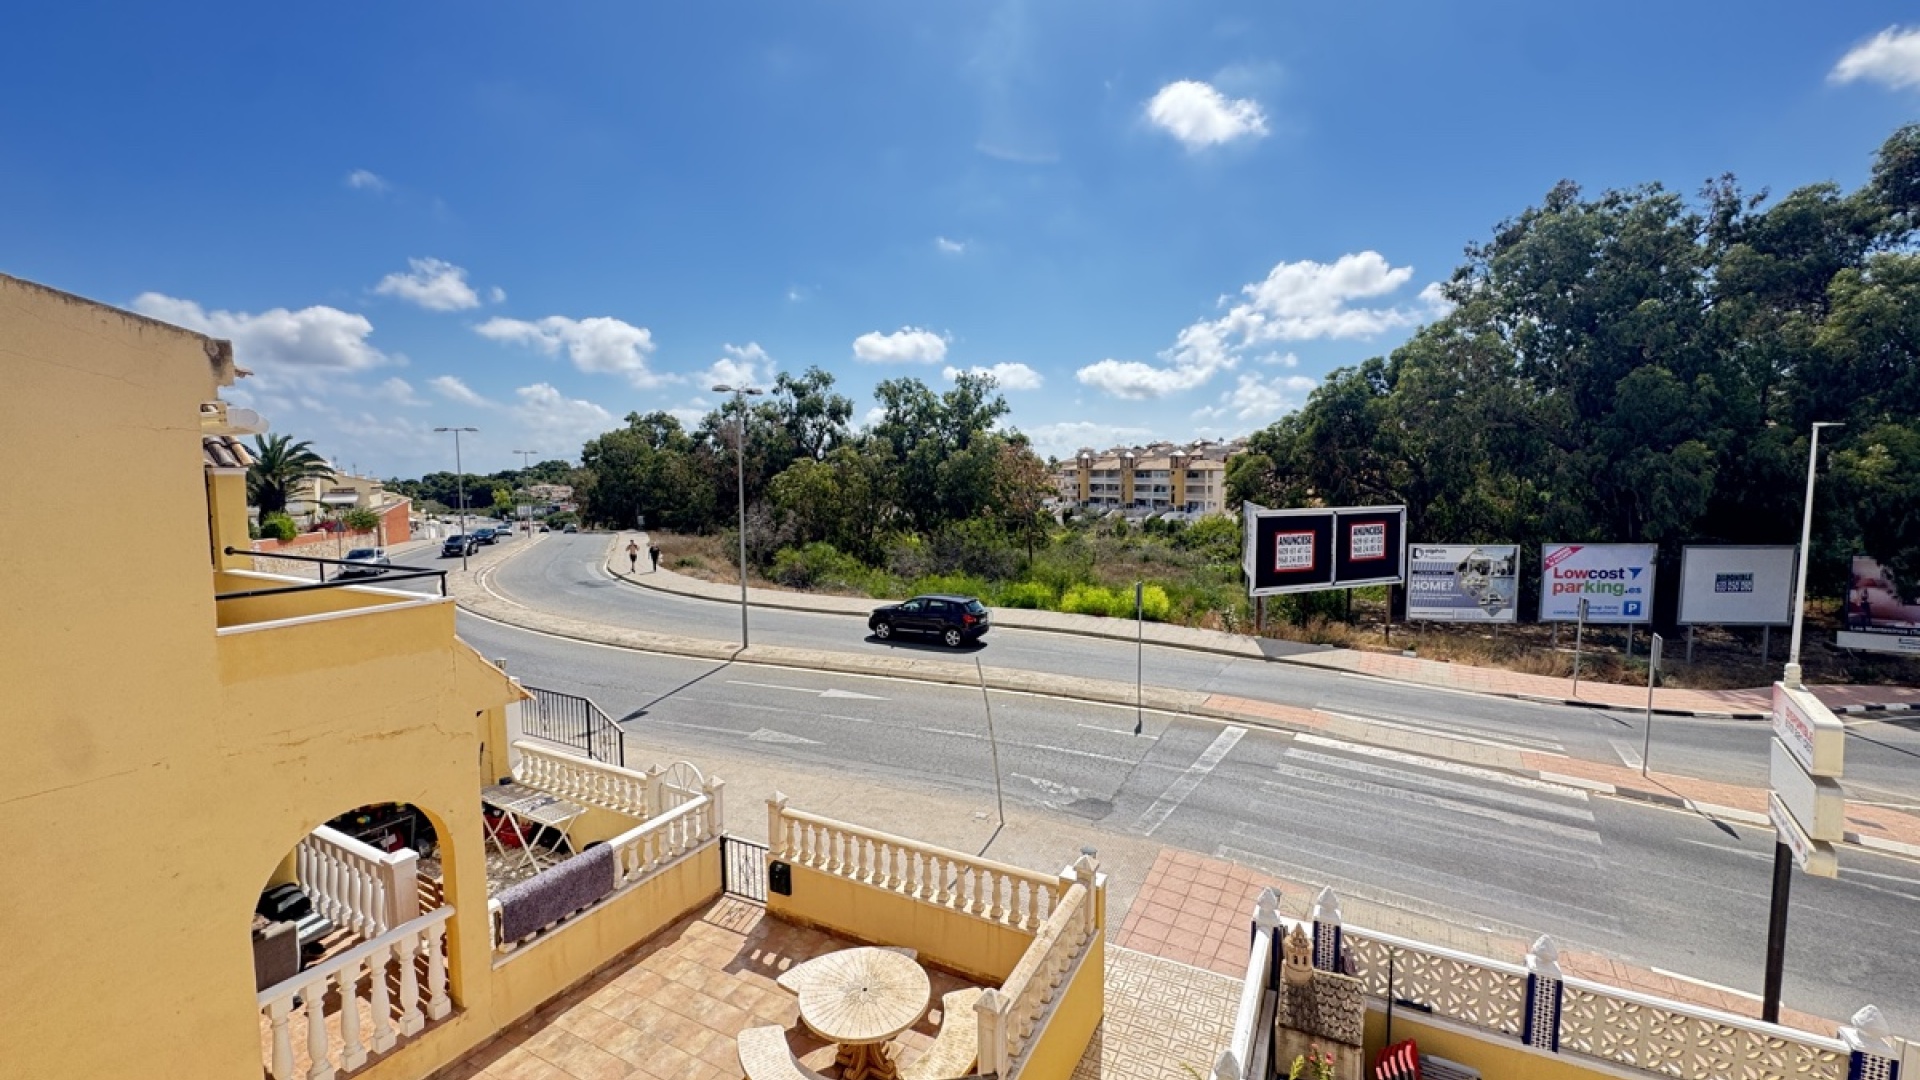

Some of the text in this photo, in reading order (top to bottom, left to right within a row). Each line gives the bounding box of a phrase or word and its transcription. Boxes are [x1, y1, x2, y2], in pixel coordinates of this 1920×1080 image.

[1353, 526, 1382, 535] ANUNCIESE
[1279, 536, 1311, 545] ANUNCIESE
[1553, 567, 1625, 579] Lowcost
[1411, 581, 1454, 591] HOME?
[1552, 580, 1642, 597] parking.es
[1628, 603, 1637, 613] P
